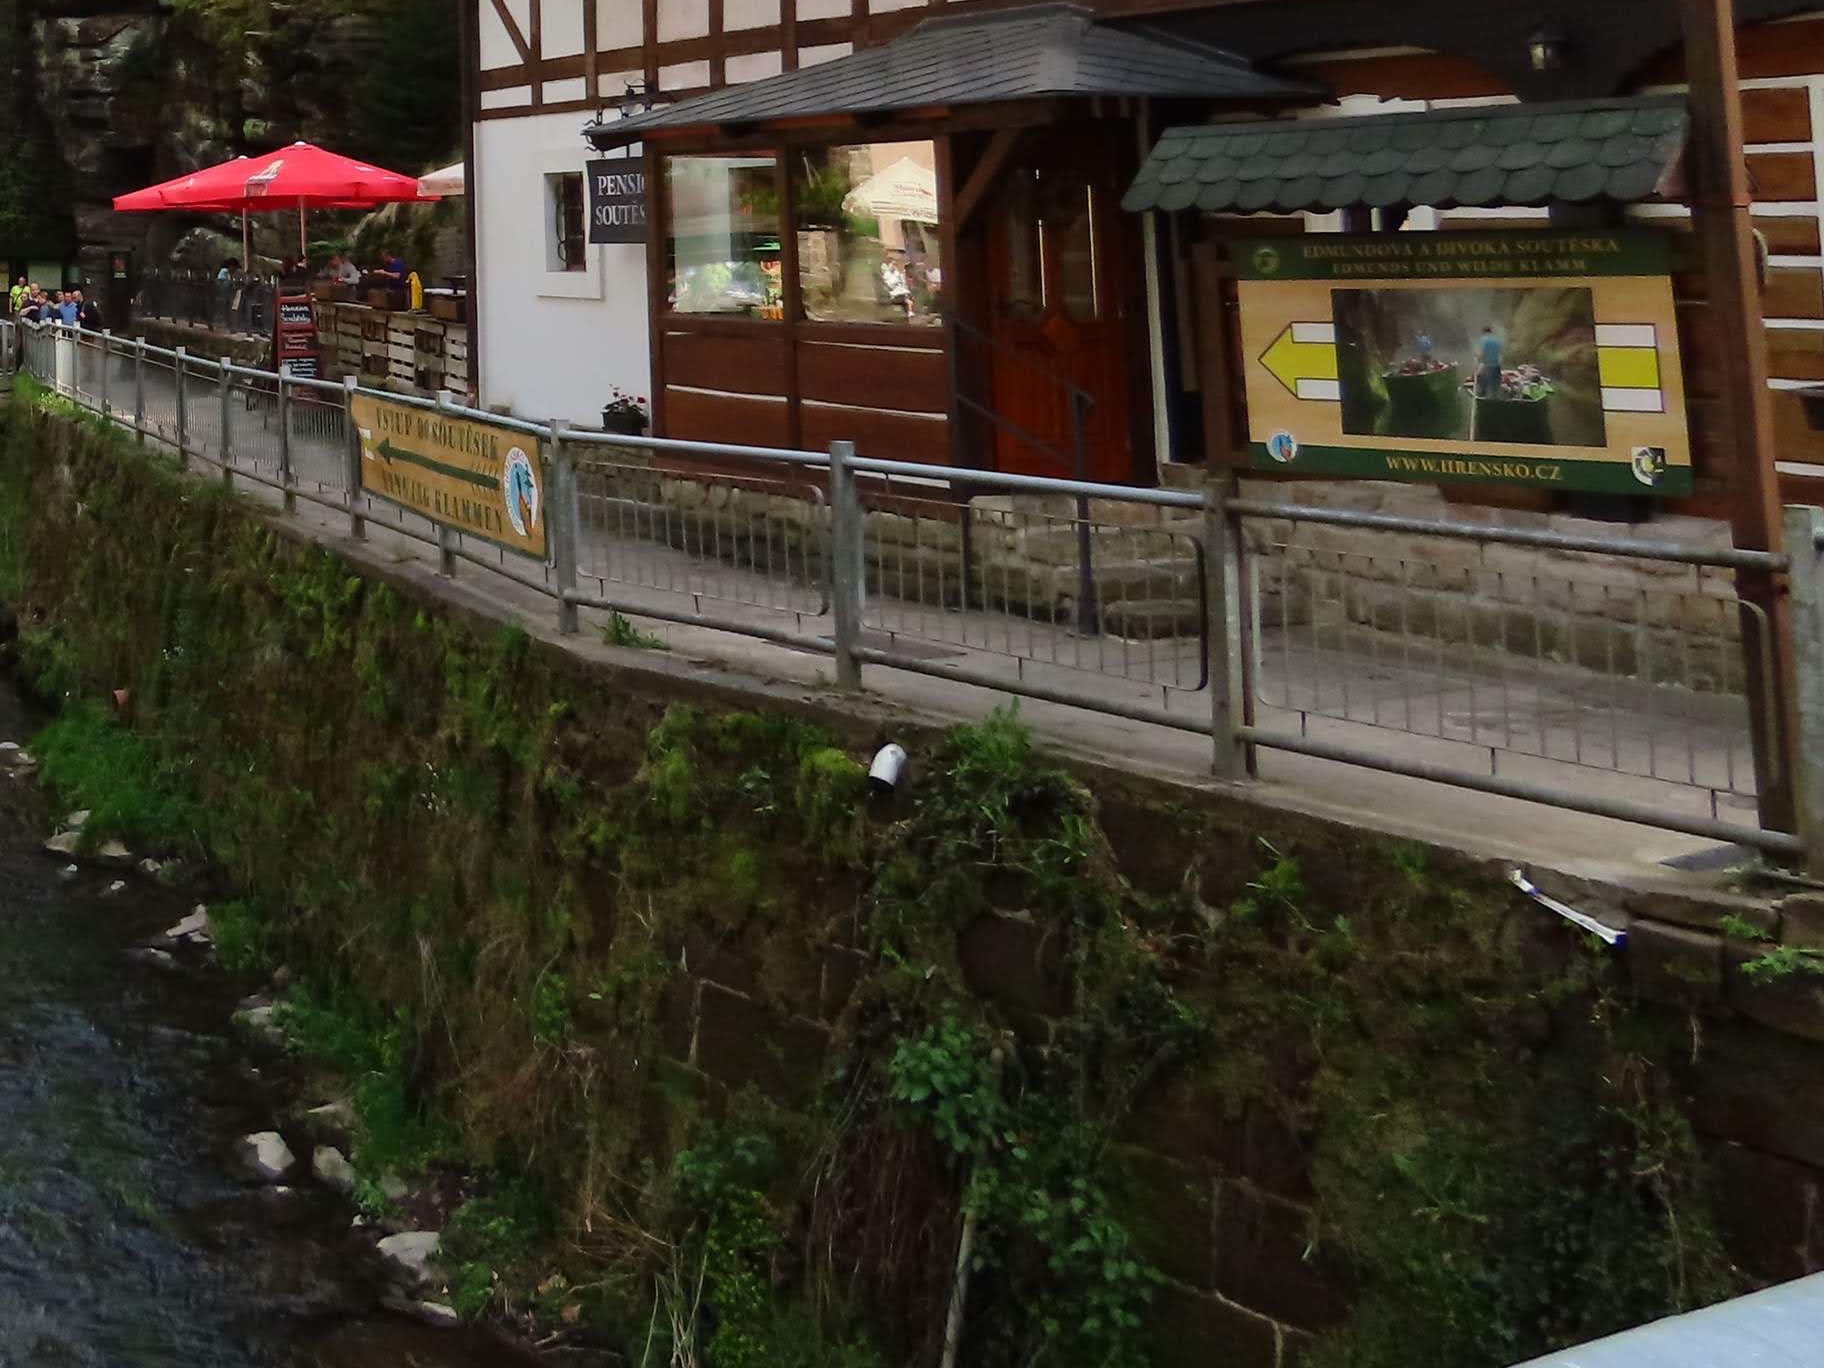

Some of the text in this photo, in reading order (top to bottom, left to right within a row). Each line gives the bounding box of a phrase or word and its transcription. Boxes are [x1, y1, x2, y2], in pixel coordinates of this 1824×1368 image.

[1303, 241, 1414, 259] EDMUNDOVA
[1414, 260, 1452, 274] UND
[375, 406, 412, 436] VSTUP
[1385, 455, 1563, 480] WWW.HRENSKO.CZ
[434, 487, 503, 535] KLAMMEN
